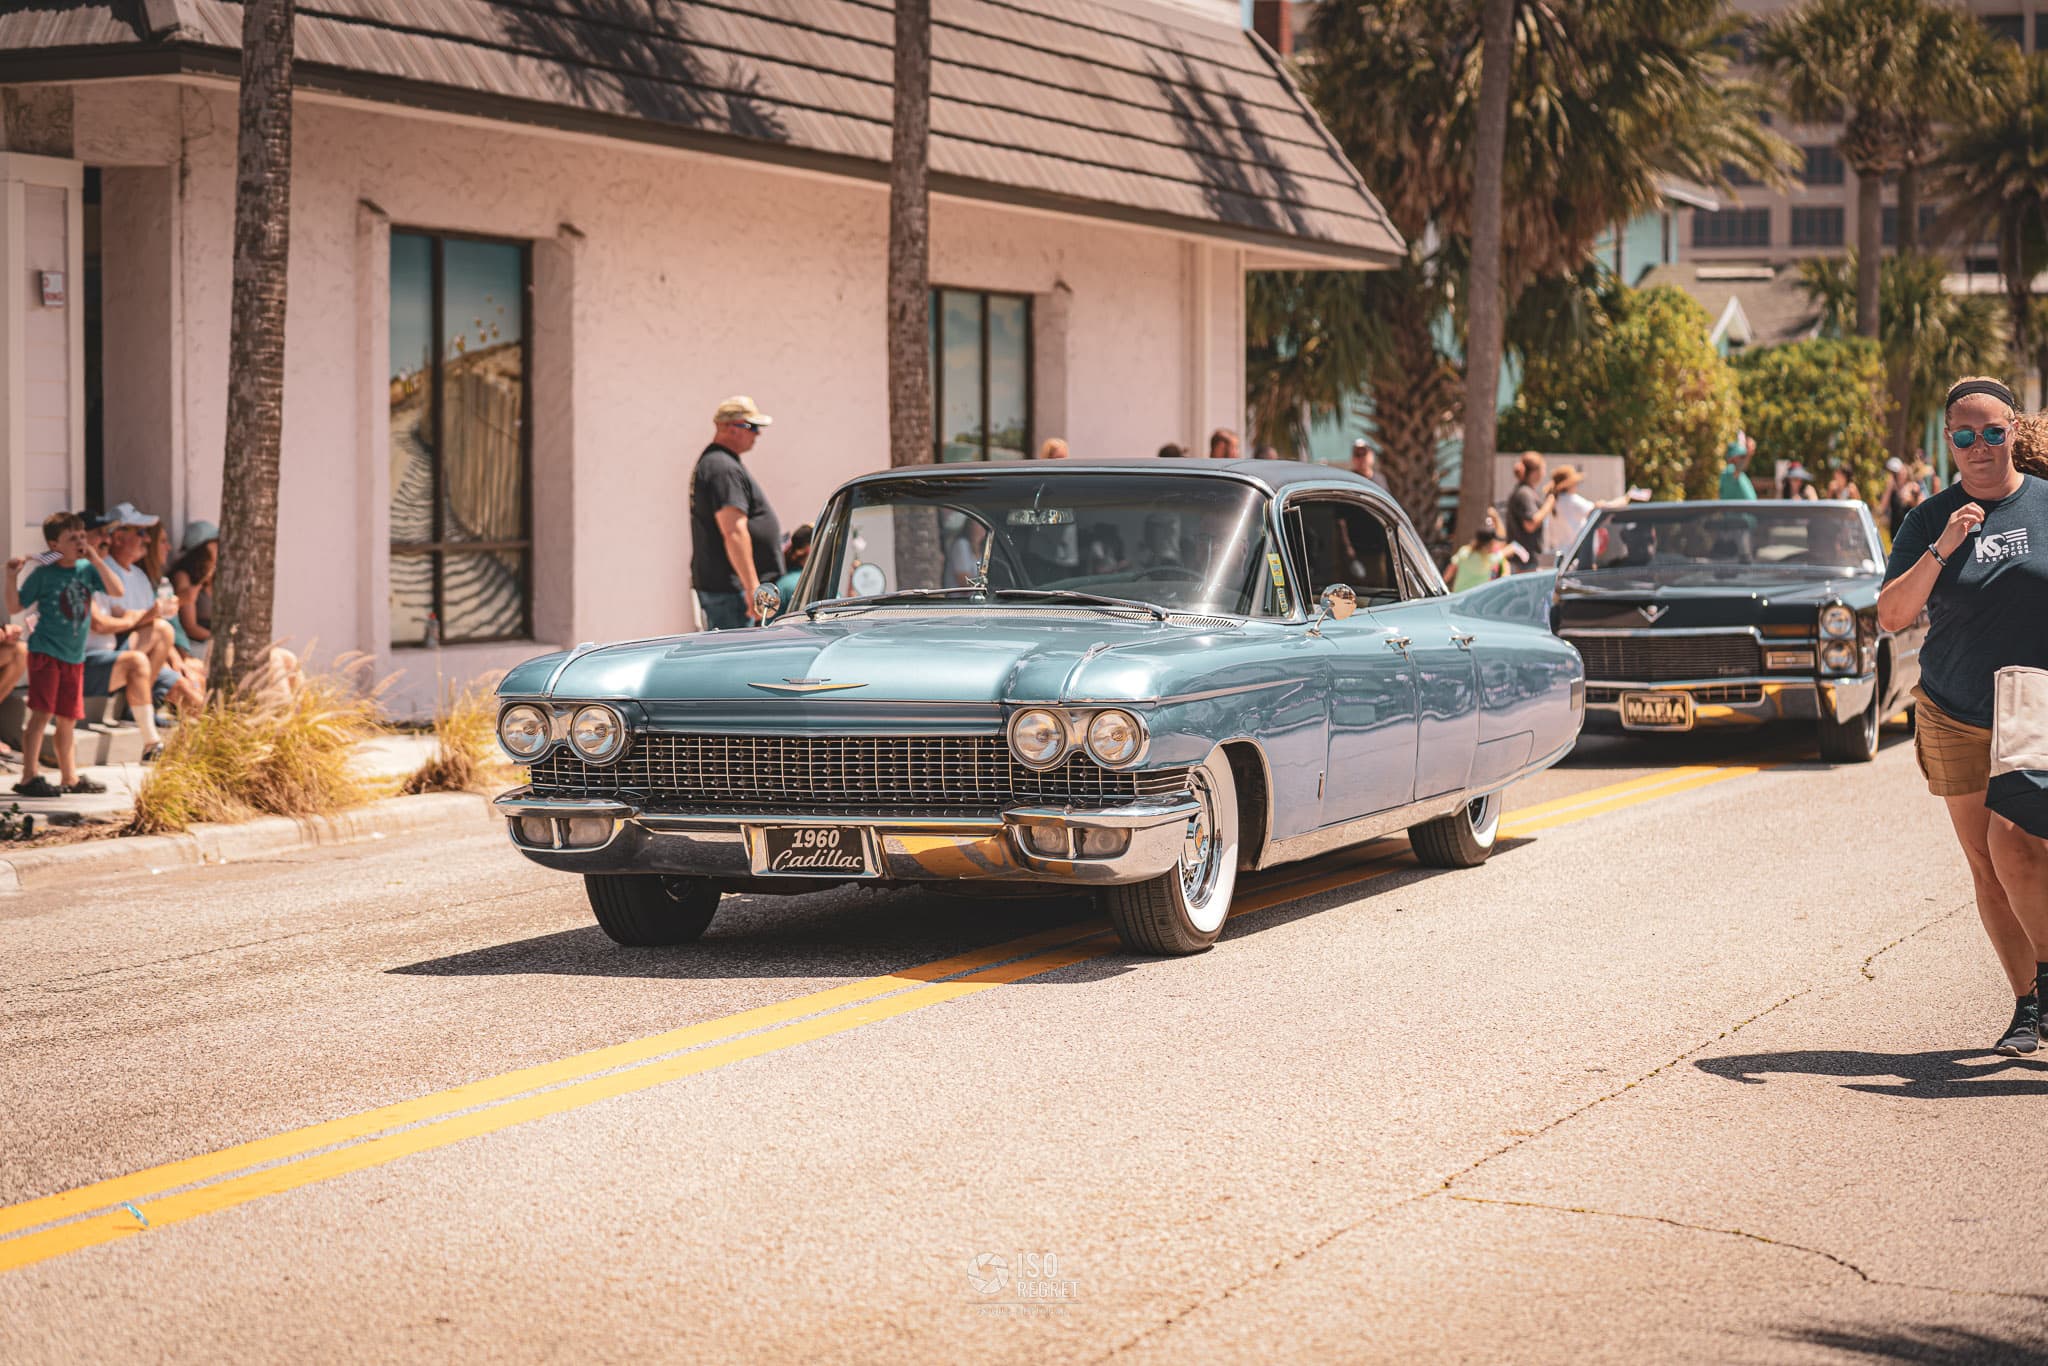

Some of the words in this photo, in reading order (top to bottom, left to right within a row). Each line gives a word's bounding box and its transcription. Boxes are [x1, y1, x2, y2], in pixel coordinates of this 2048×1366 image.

[1628, 702, 1685, 718] MAFIA
[792, 829, 840, 848] 1960
[772, 849, 862, 871] Cadillac
